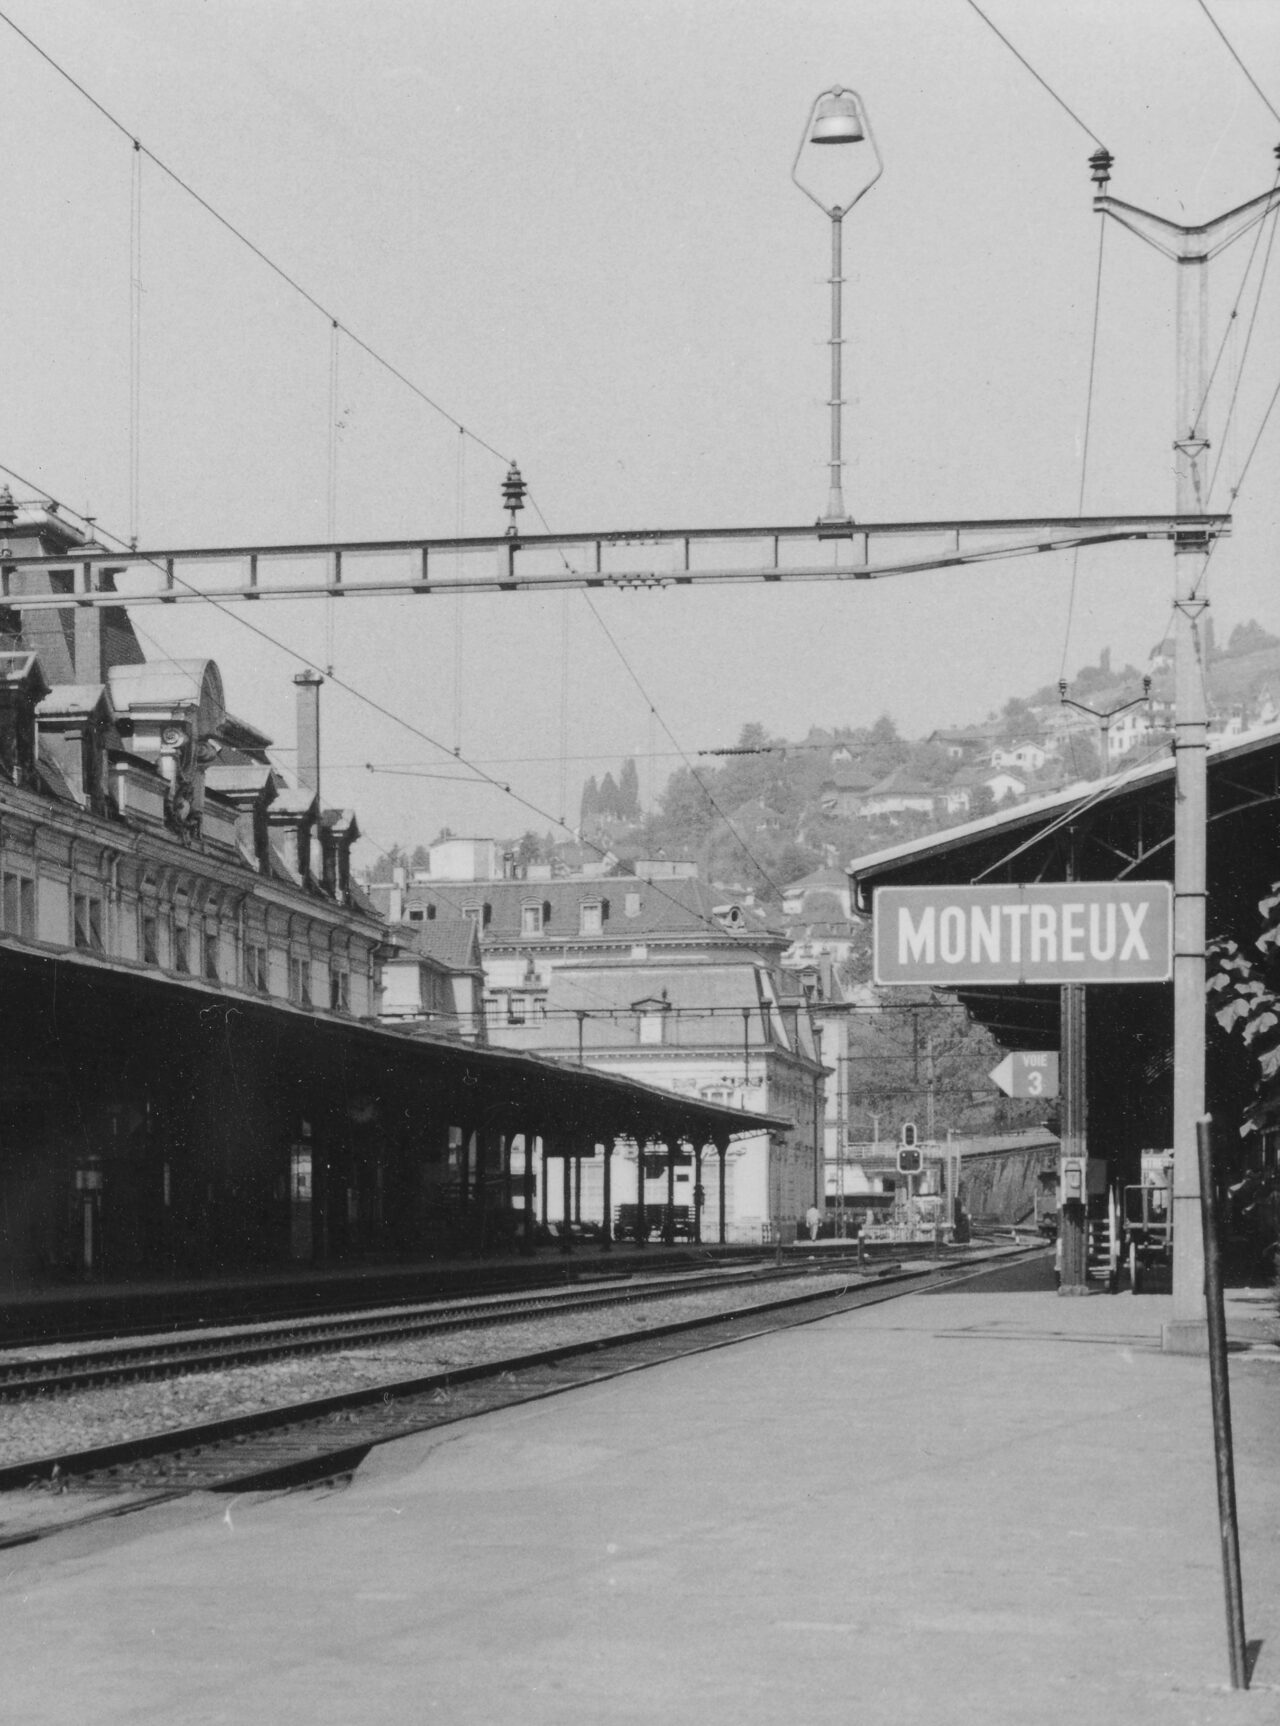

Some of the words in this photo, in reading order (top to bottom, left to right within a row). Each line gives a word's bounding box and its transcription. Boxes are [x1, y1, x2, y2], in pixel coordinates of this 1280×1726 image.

[897, 902, 1150, 965] MONTREUX
[1023, 1053, 1048, 1067] VOIE
[1028, 1071, 1042, 1095] 3
